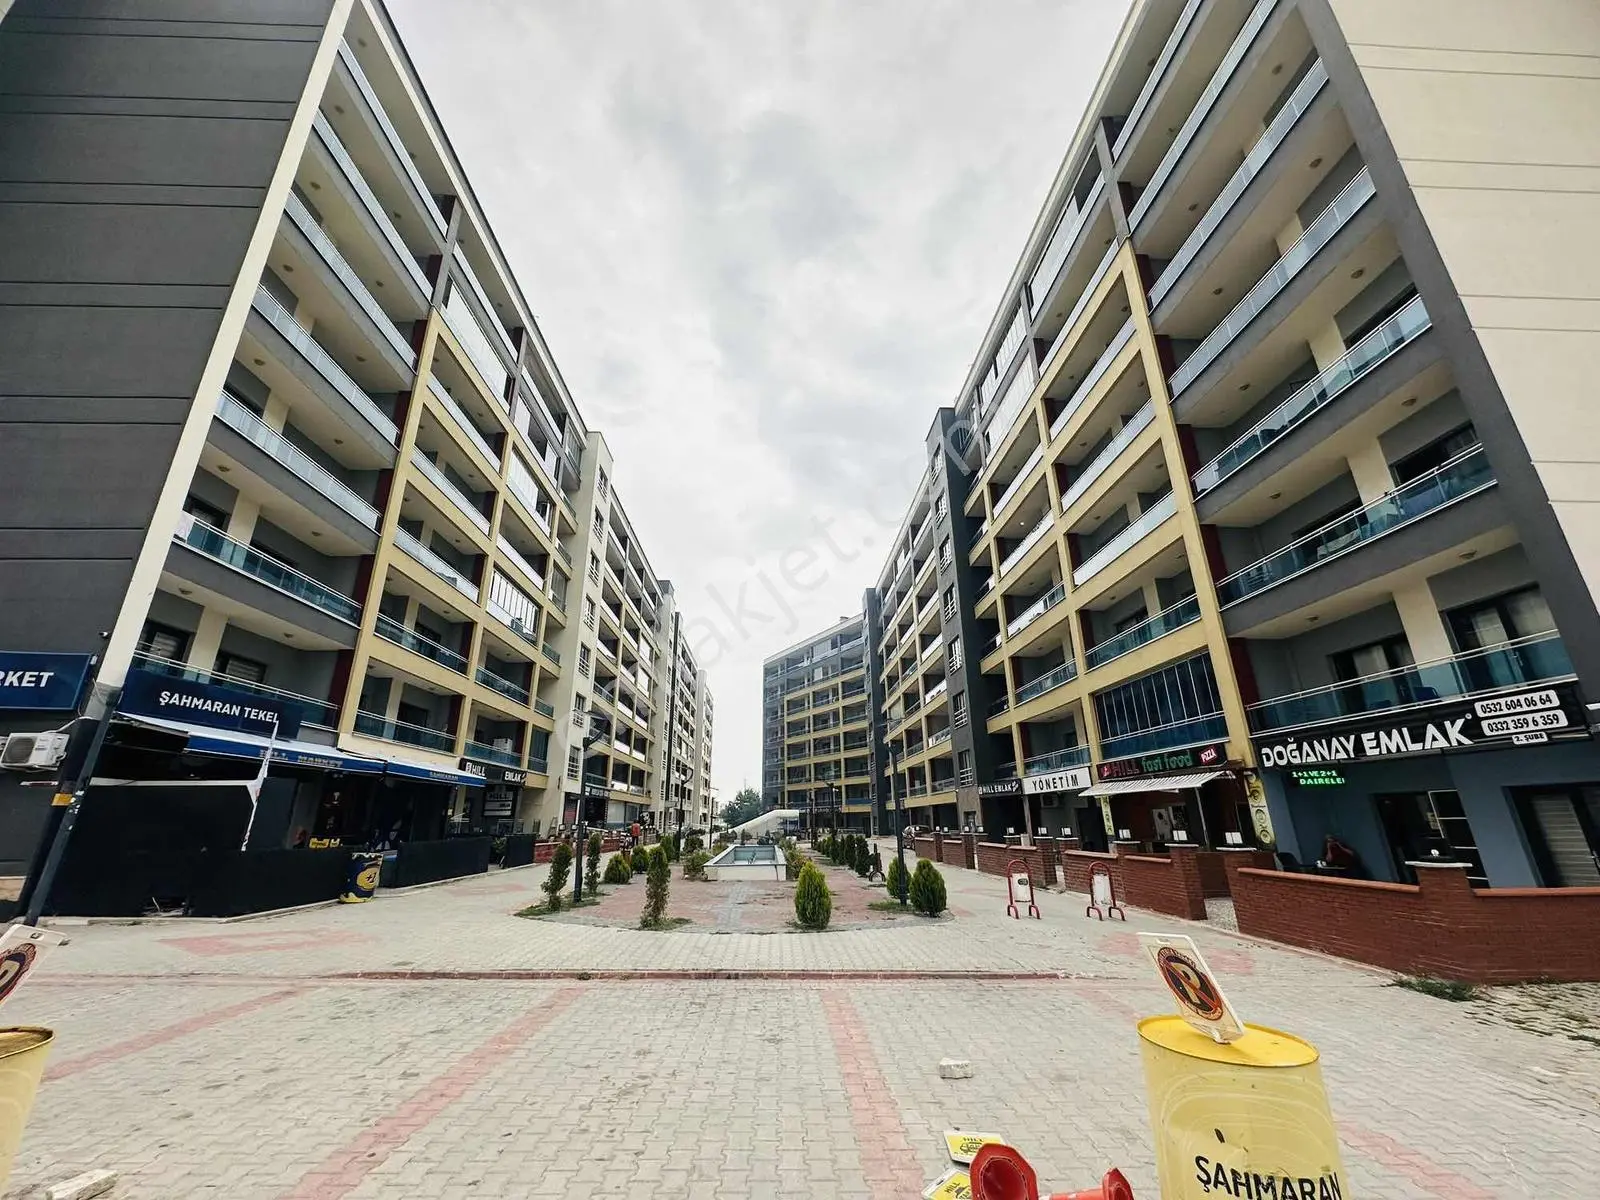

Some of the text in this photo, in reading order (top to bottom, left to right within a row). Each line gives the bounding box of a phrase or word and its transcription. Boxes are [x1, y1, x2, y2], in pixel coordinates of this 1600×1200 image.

[159, 691, 279, 723] ŞAHMARAN TEKEL
[1480, 693, 1552, 714] 0532 604 06 64
[1487, 713, 1560, 732] 0332 359 6 359
[1261, 718, 1475, 767] DOĞANAY EMLAK
[1524, 732, 1545, 742] ŞUBE
[471, 764, 486, 777] HILL
[1112, 749, 1193, 777] HILL fast food
[1031, 773, 1079, 792] YÖNETİM
